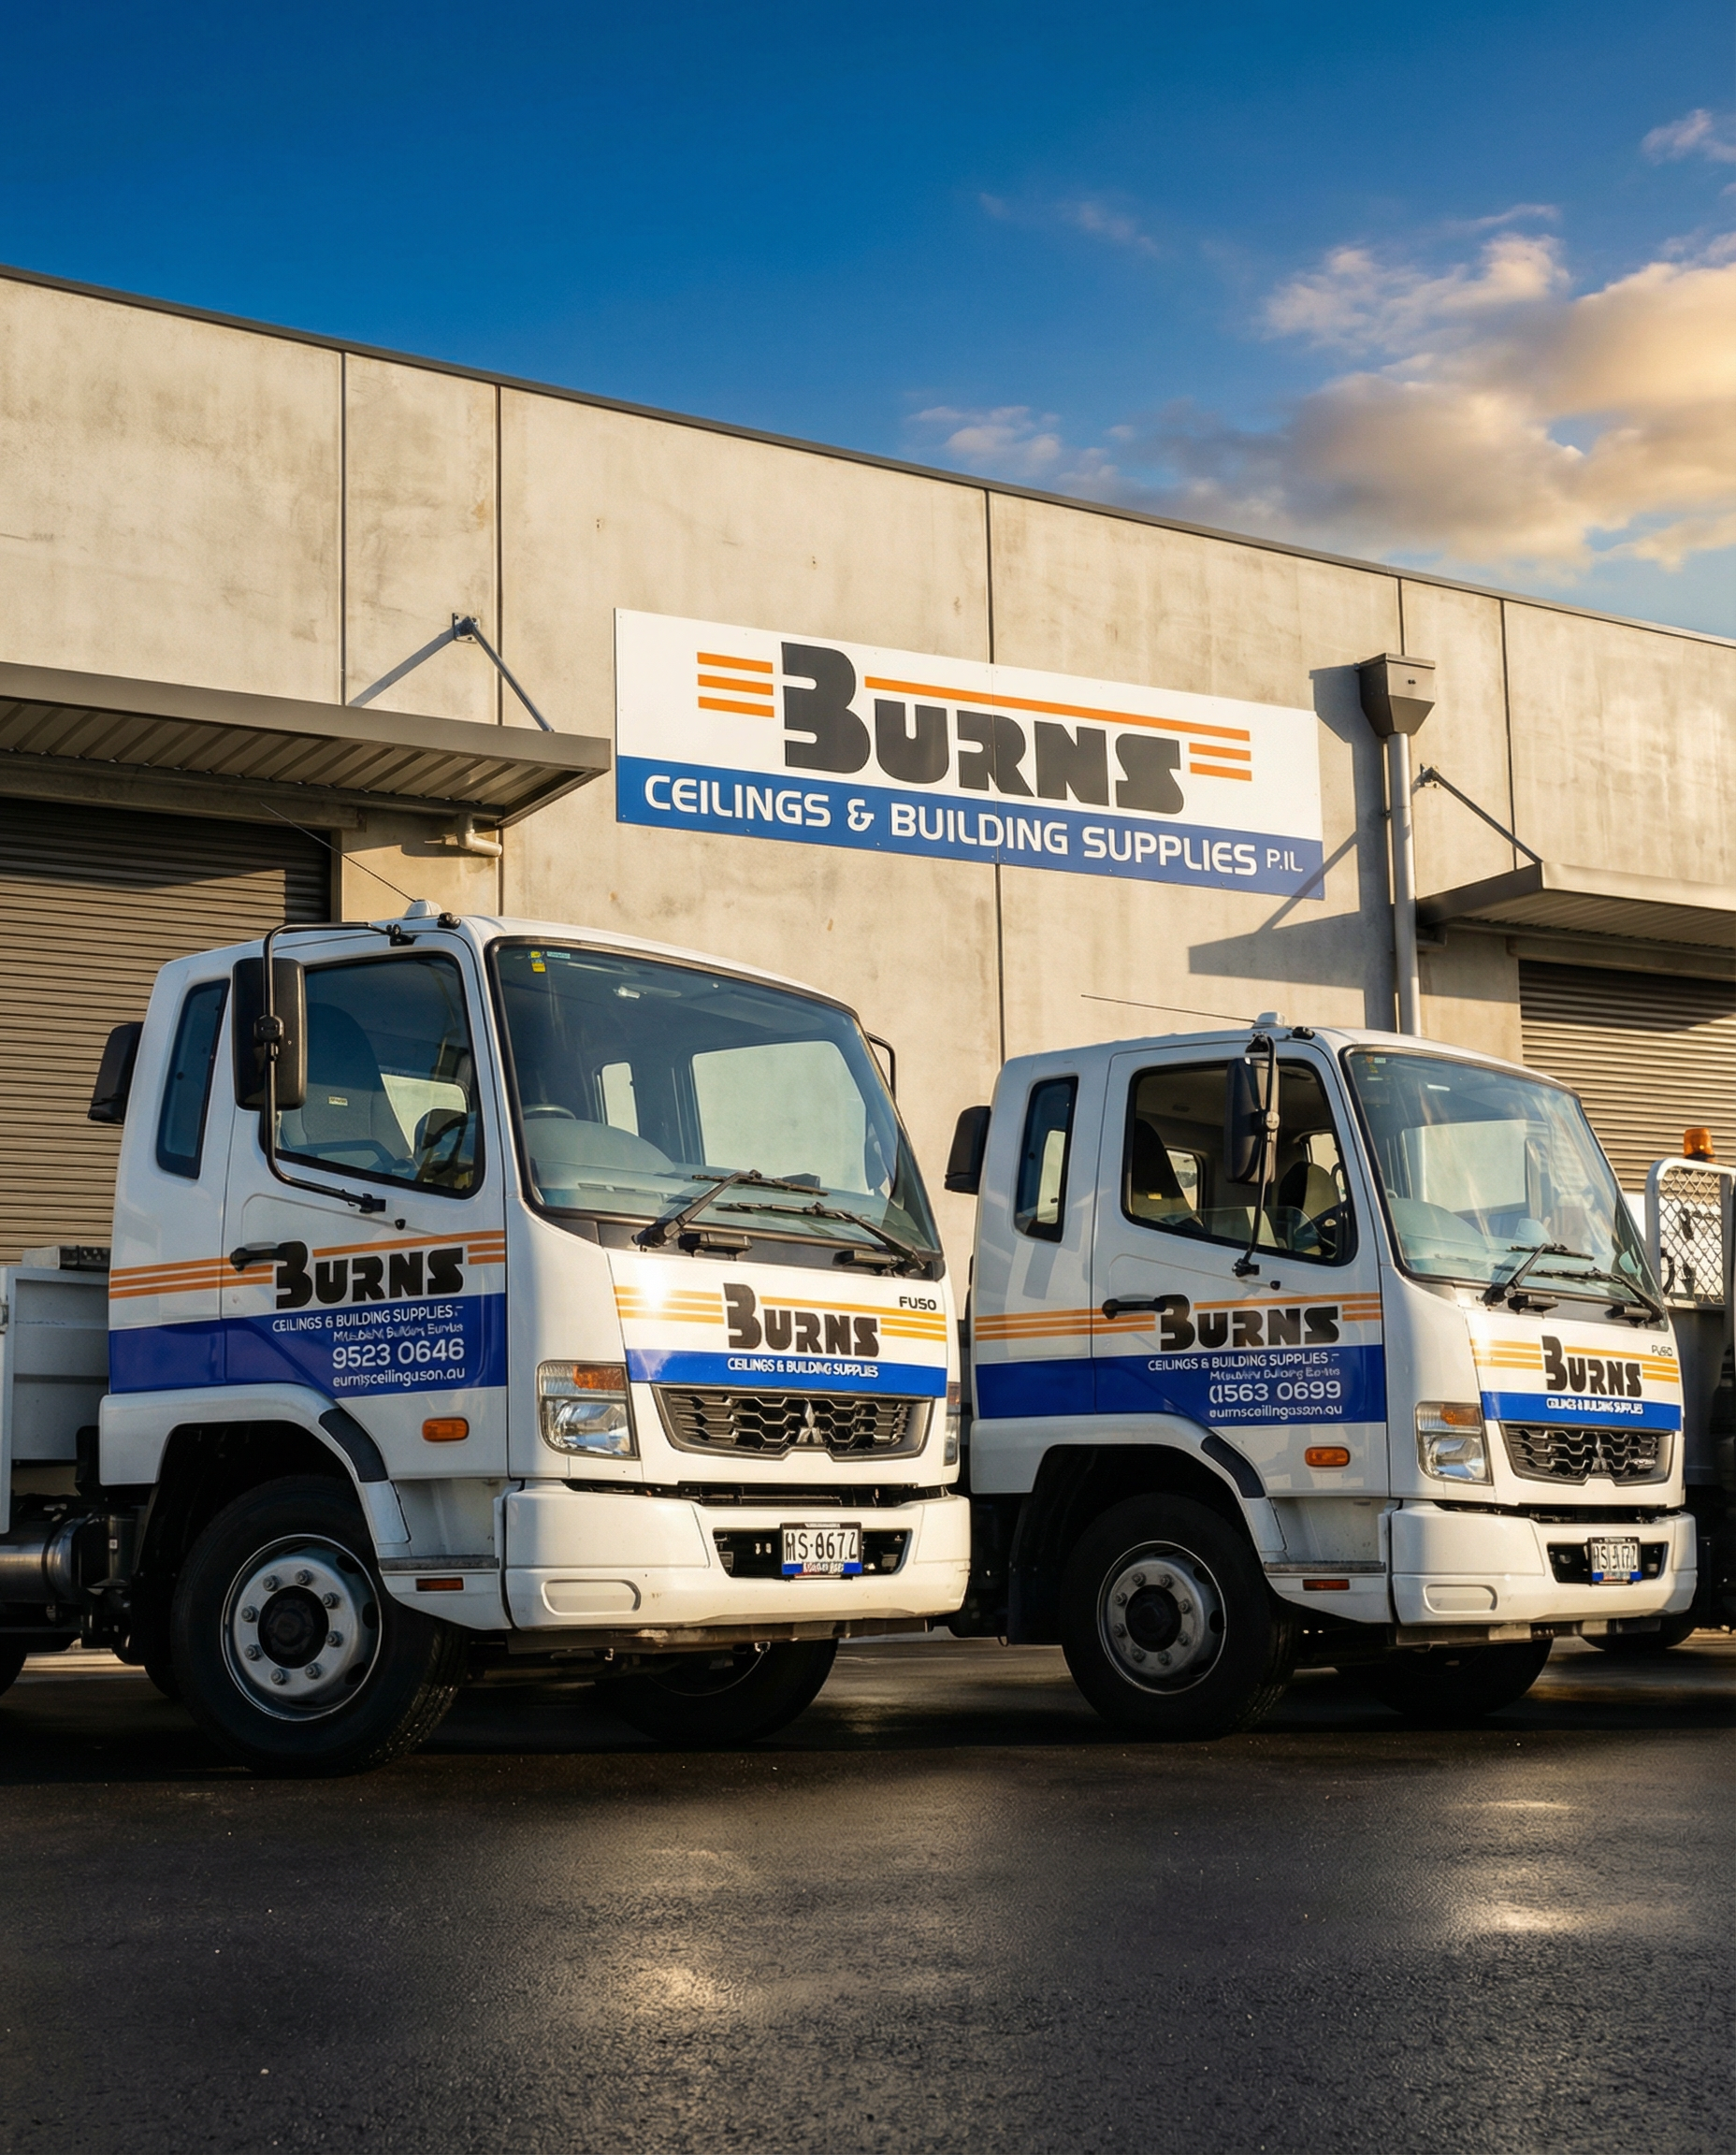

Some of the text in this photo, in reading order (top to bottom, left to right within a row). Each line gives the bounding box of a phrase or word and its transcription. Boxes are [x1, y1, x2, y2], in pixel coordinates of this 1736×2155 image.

[781, 642, 1184, 815] BURNS
[644, 774, 832, 828] CEILINGS
[847, 798, 875, 832] &
[890, 803, 1068, 856] BUILDING
[1082, 826, 1258, 876] SUPPLIES
[276, 1241, 464, 1309] BURNS
[899, 1295, 937, 1311] FUSO
[272, 1316, 323, 1333] CEILINGS
[336, 1310, 391, 1327] BUILDING
[723, 1282, 879, 1357] BURNS
[1161, 1294, 1339, 1352] BURNS
[332, 1338, 464, 1369] 9523 0646
[1148, 1358, 1199, 1371] CEILINGS
[1211, 1355, 1267, 1368] BUILDING
[1541, 1335, 1642, 1397] BURNS
[1277, 1381, 1341, 1400] 0699
